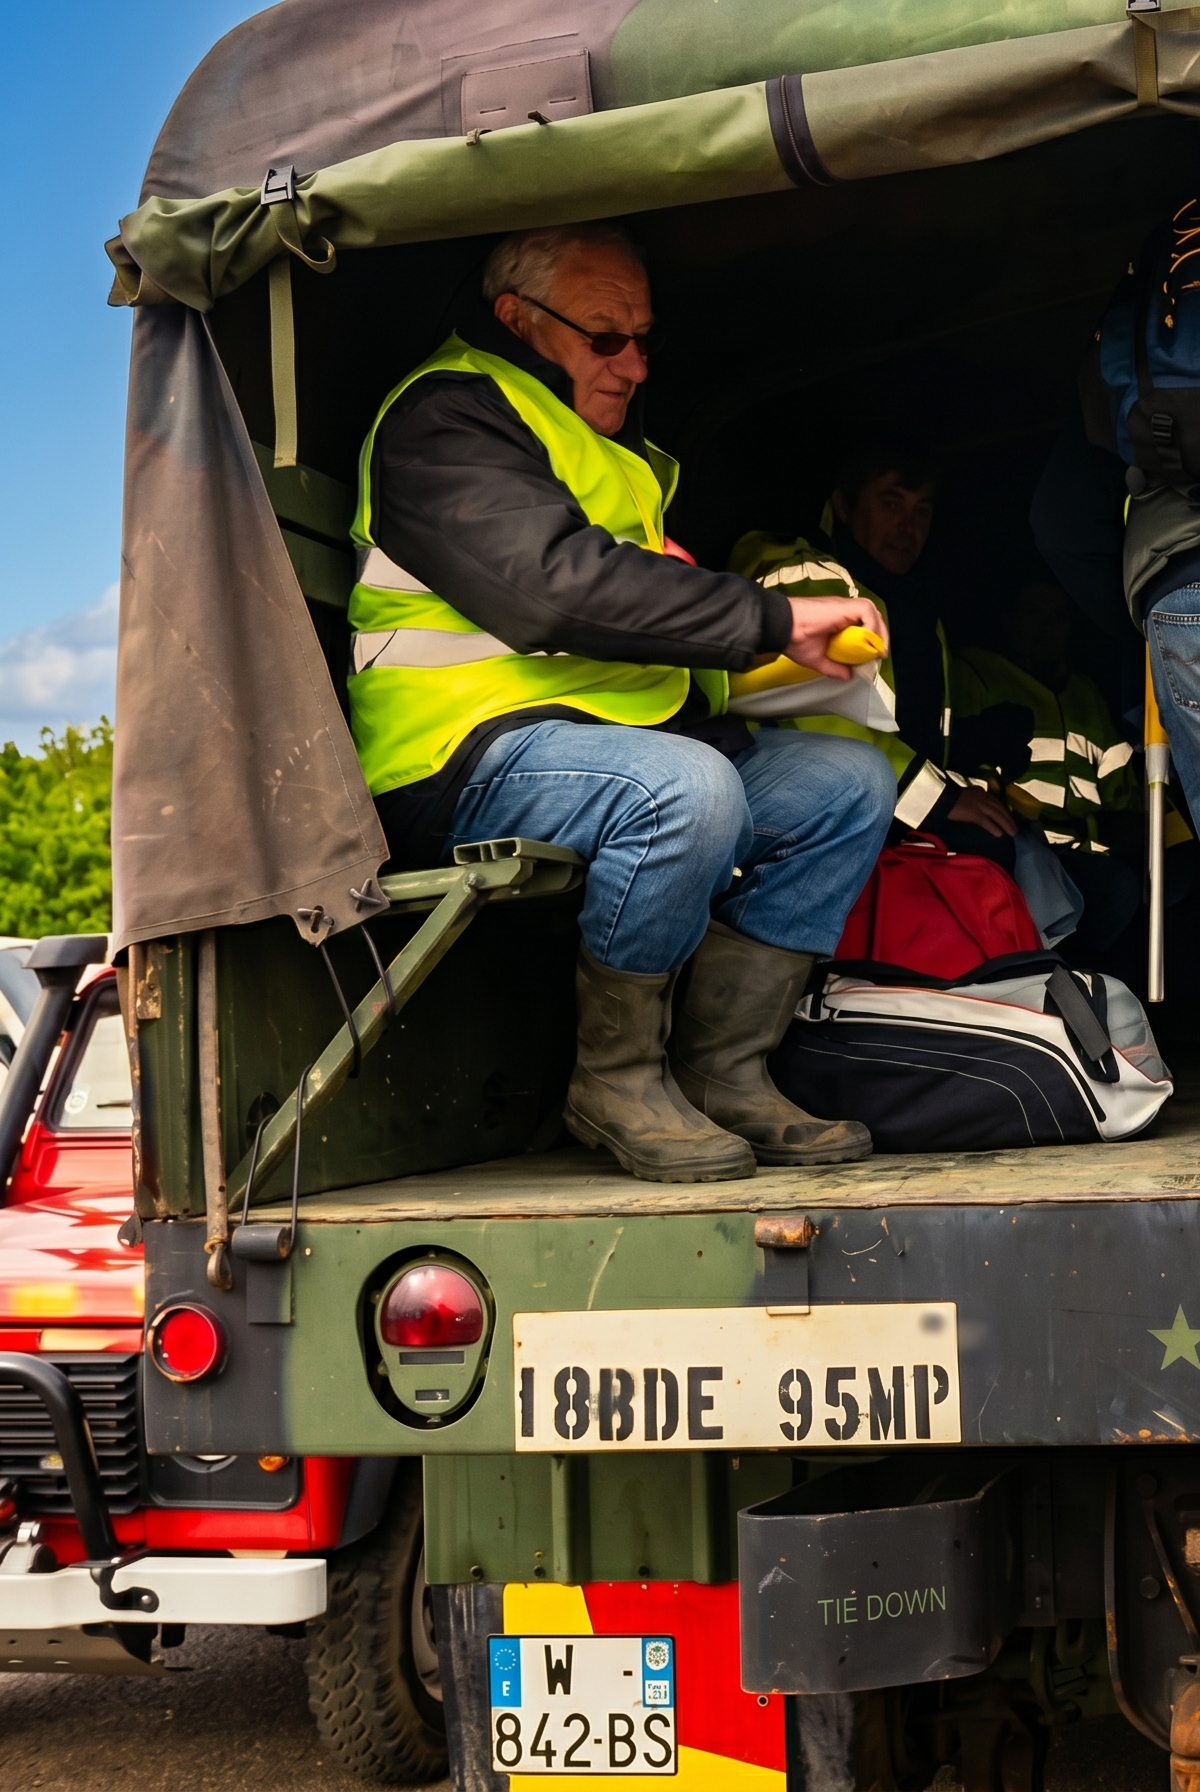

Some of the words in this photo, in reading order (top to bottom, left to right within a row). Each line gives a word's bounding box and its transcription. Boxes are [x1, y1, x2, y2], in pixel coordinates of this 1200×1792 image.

[778, 1364, 950, 1442] 95MP
[817, 1597, 858, 1626] TIE
[867, 1586, 946, 1621] DOWN
[544, 1644, 573, 1695] W
[495, 1712, 672, 1768] 842-BS
